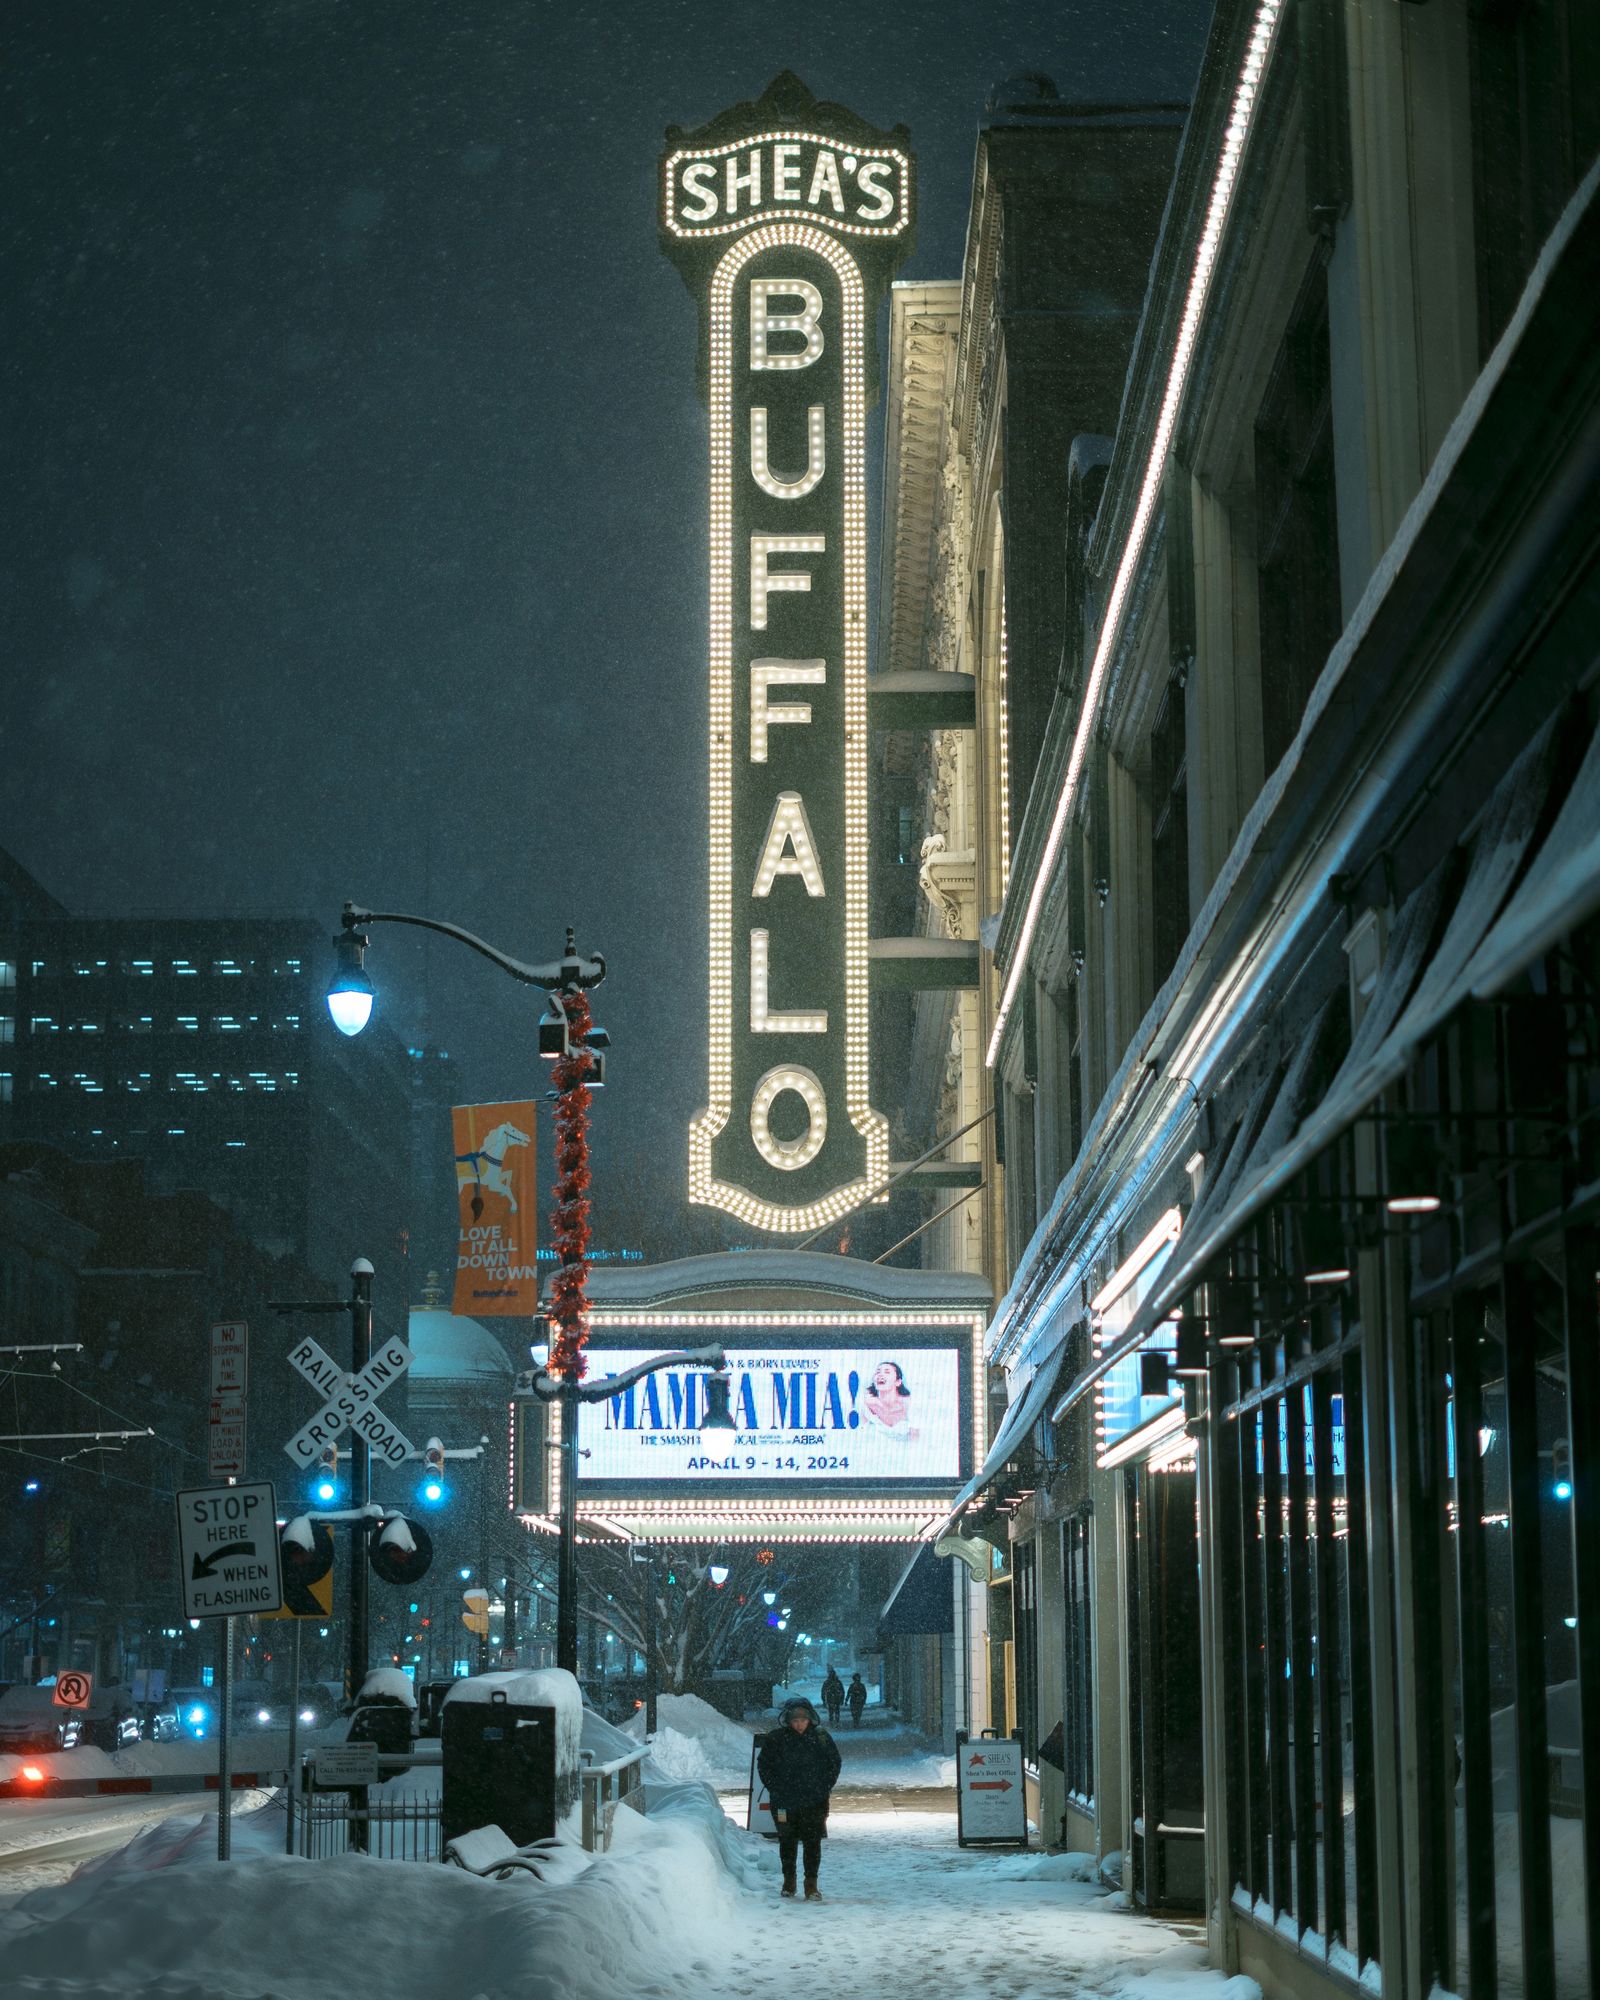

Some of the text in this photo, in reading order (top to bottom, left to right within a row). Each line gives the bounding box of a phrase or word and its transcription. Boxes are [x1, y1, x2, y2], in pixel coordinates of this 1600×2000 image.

[681, 144, 894, 221] SHEA'S
[750, 278, 827, 1171] BUFFALO
[458, 1225, 501, 1242] LOVE
[472, 1238, 518, 1254] IT ALL
[457, 1252, 509, 1269] DOWN
[486, 1265, 537, 1281] TOWN
[222, 1327, 235, 1342] NO
[212, 1344, 244, 1356] STOPPING
[221, 1358, 235, 1368] ANY
[220, 1370, 236, 1381] TIME
[294, 1345, 407, 1462] RAIL ROAD
[296, 1349, 404, 1457] CROSSING
[605, 1370, 859, 1430] MAMA MIA!
[211, 1407, 221, 1420] NO
[212, 1438, 241, 1449] LOAD &
[211, 1449, 242, 1461] UNLOAD
[687, 1457, 740, 1469] APRIL
[745, 1457, 755, 1469] 9
[775, 1457, 800, 1471] 14,
[807, 1457, 849, 1469] 2024
[193, 1494, 259, 1523] STOP
[207, 1524, 248, 1542] HERE
[223, 1564, 269, 1582] WHEN
[193, 1586, 272, 1608] FLASHING
[988, 1753, 1011, 1764] SHEA'S
